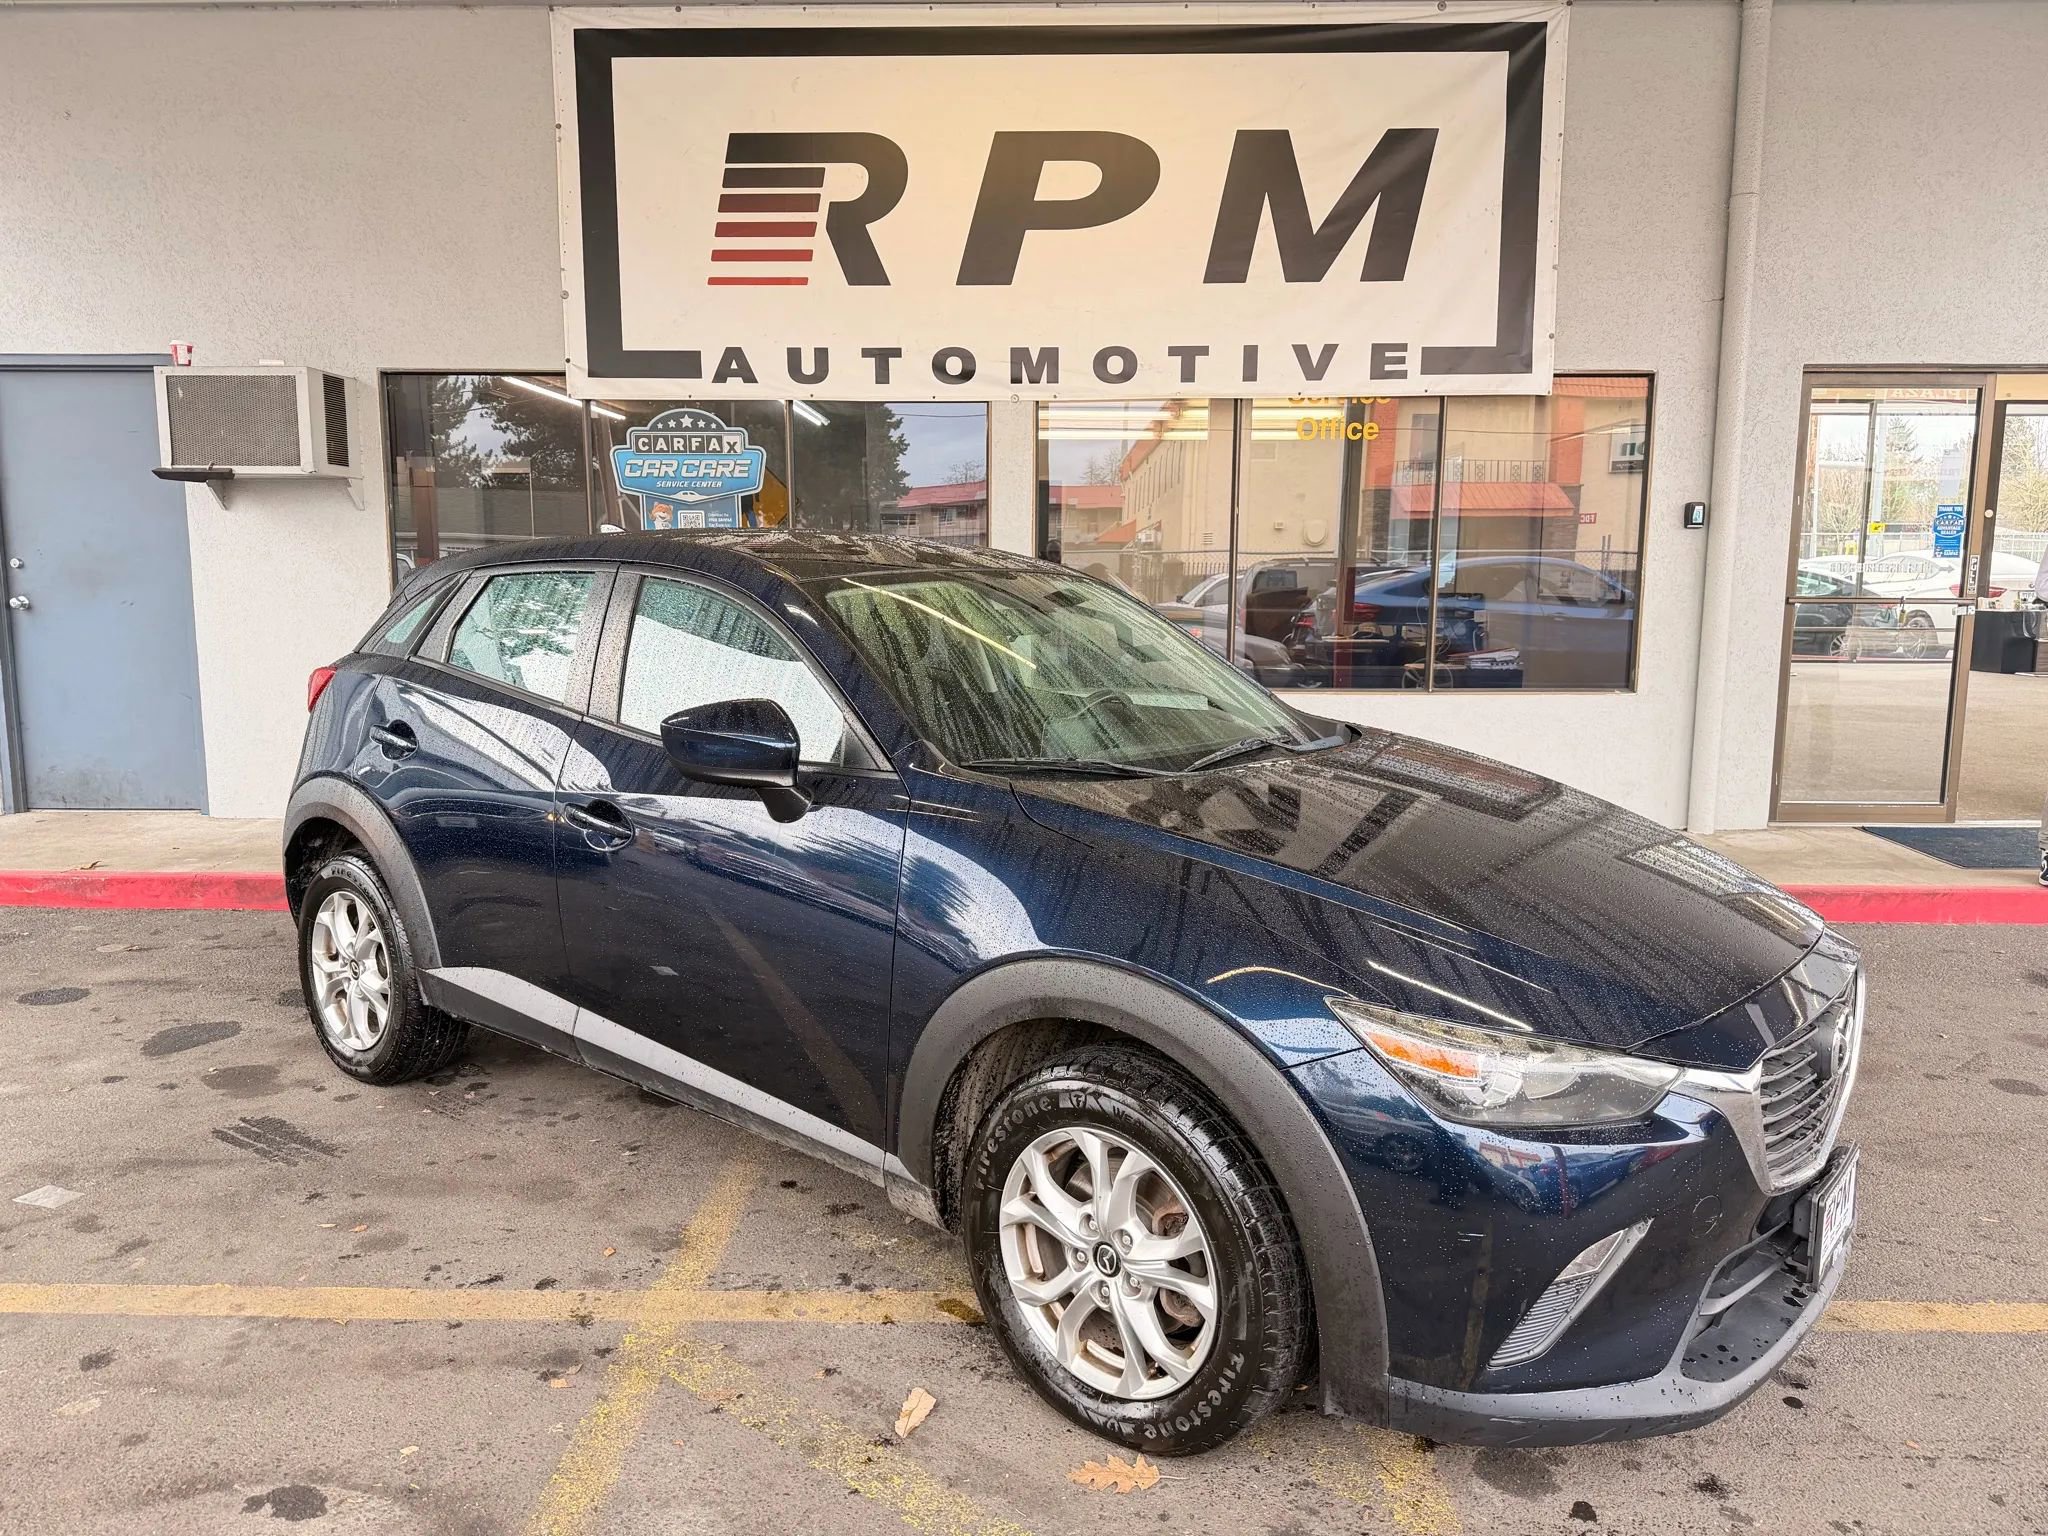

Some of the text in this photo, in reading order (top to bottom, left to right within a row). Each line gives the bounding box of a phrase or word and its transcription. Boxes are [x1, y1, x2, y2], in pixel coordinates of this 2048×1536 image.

[708, 128, 1438, 286] RPM
[711, 343, 1408, 386] AUTOMOTIVE
[1296, 417, 1380, 440] Office
[638, 437, 738, 454] CARFAX
[624, 459, 752, 478] CAR CARE
[656, 480, 722, 488] SERVICE CENTER
[1969, 558, 1978, 584] PULL
[1143, 1352, 1245, 1439] Firestone
